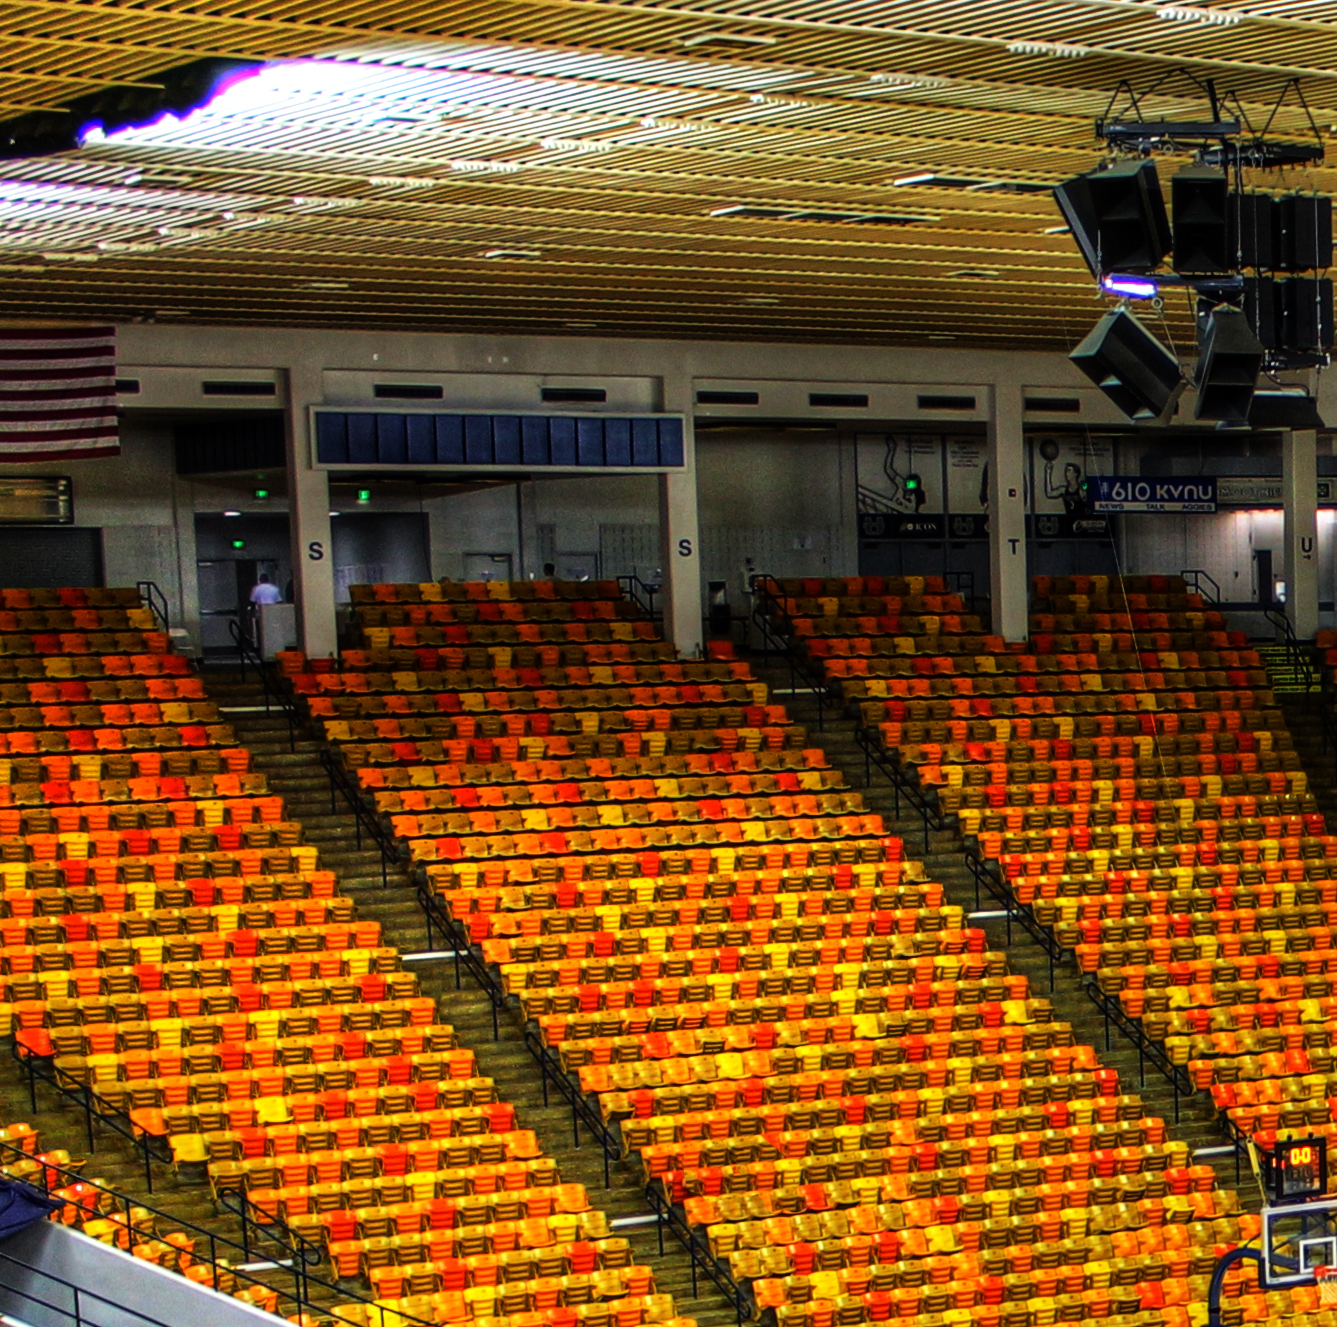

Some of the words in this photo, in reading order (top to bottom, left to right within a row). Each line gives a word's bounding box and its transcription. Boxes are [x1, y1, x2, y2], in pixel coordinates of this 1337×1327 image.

[1111, 482, 1150, 501] 610
[308, 541, 325, 561] S
[677, 538, 694, 557] S
[1007, 538, 1020, 555] T
[1301, 537, 1313, 553] U
